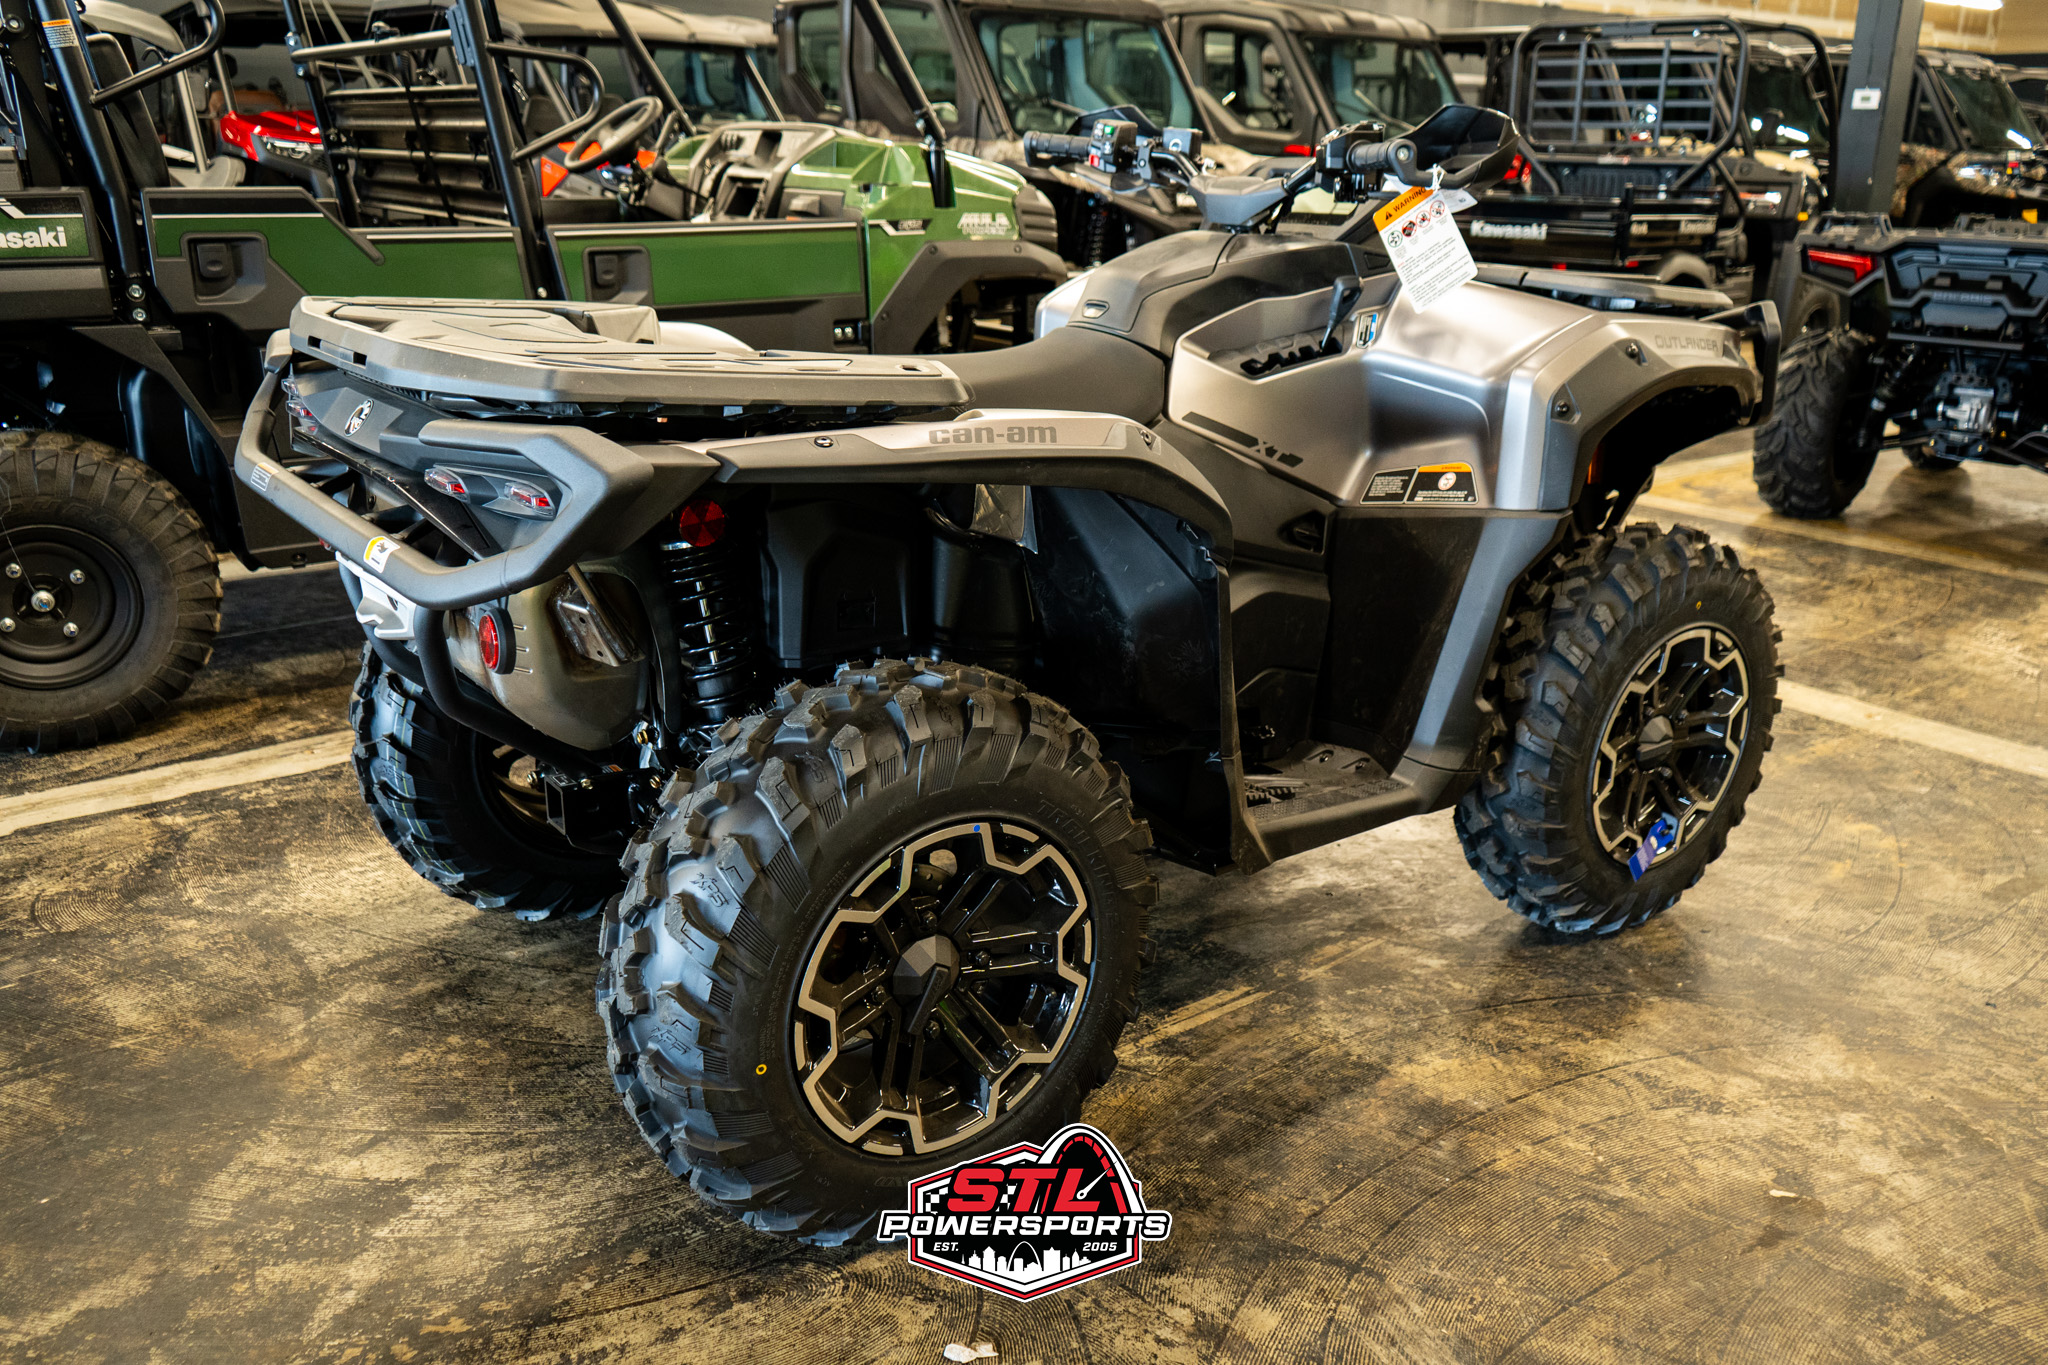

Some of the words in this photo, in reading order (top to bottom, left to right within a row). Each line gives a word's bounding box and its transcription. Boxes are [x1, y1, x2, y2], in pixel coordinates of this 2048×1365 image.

[1392, 186, 1426, 212] WARNING
[1470, 219, 1548, 240] Kawasaki
[1654, 334, 1719, 352] OUTLANDER
[929, 426, 1057, 444] can-am
